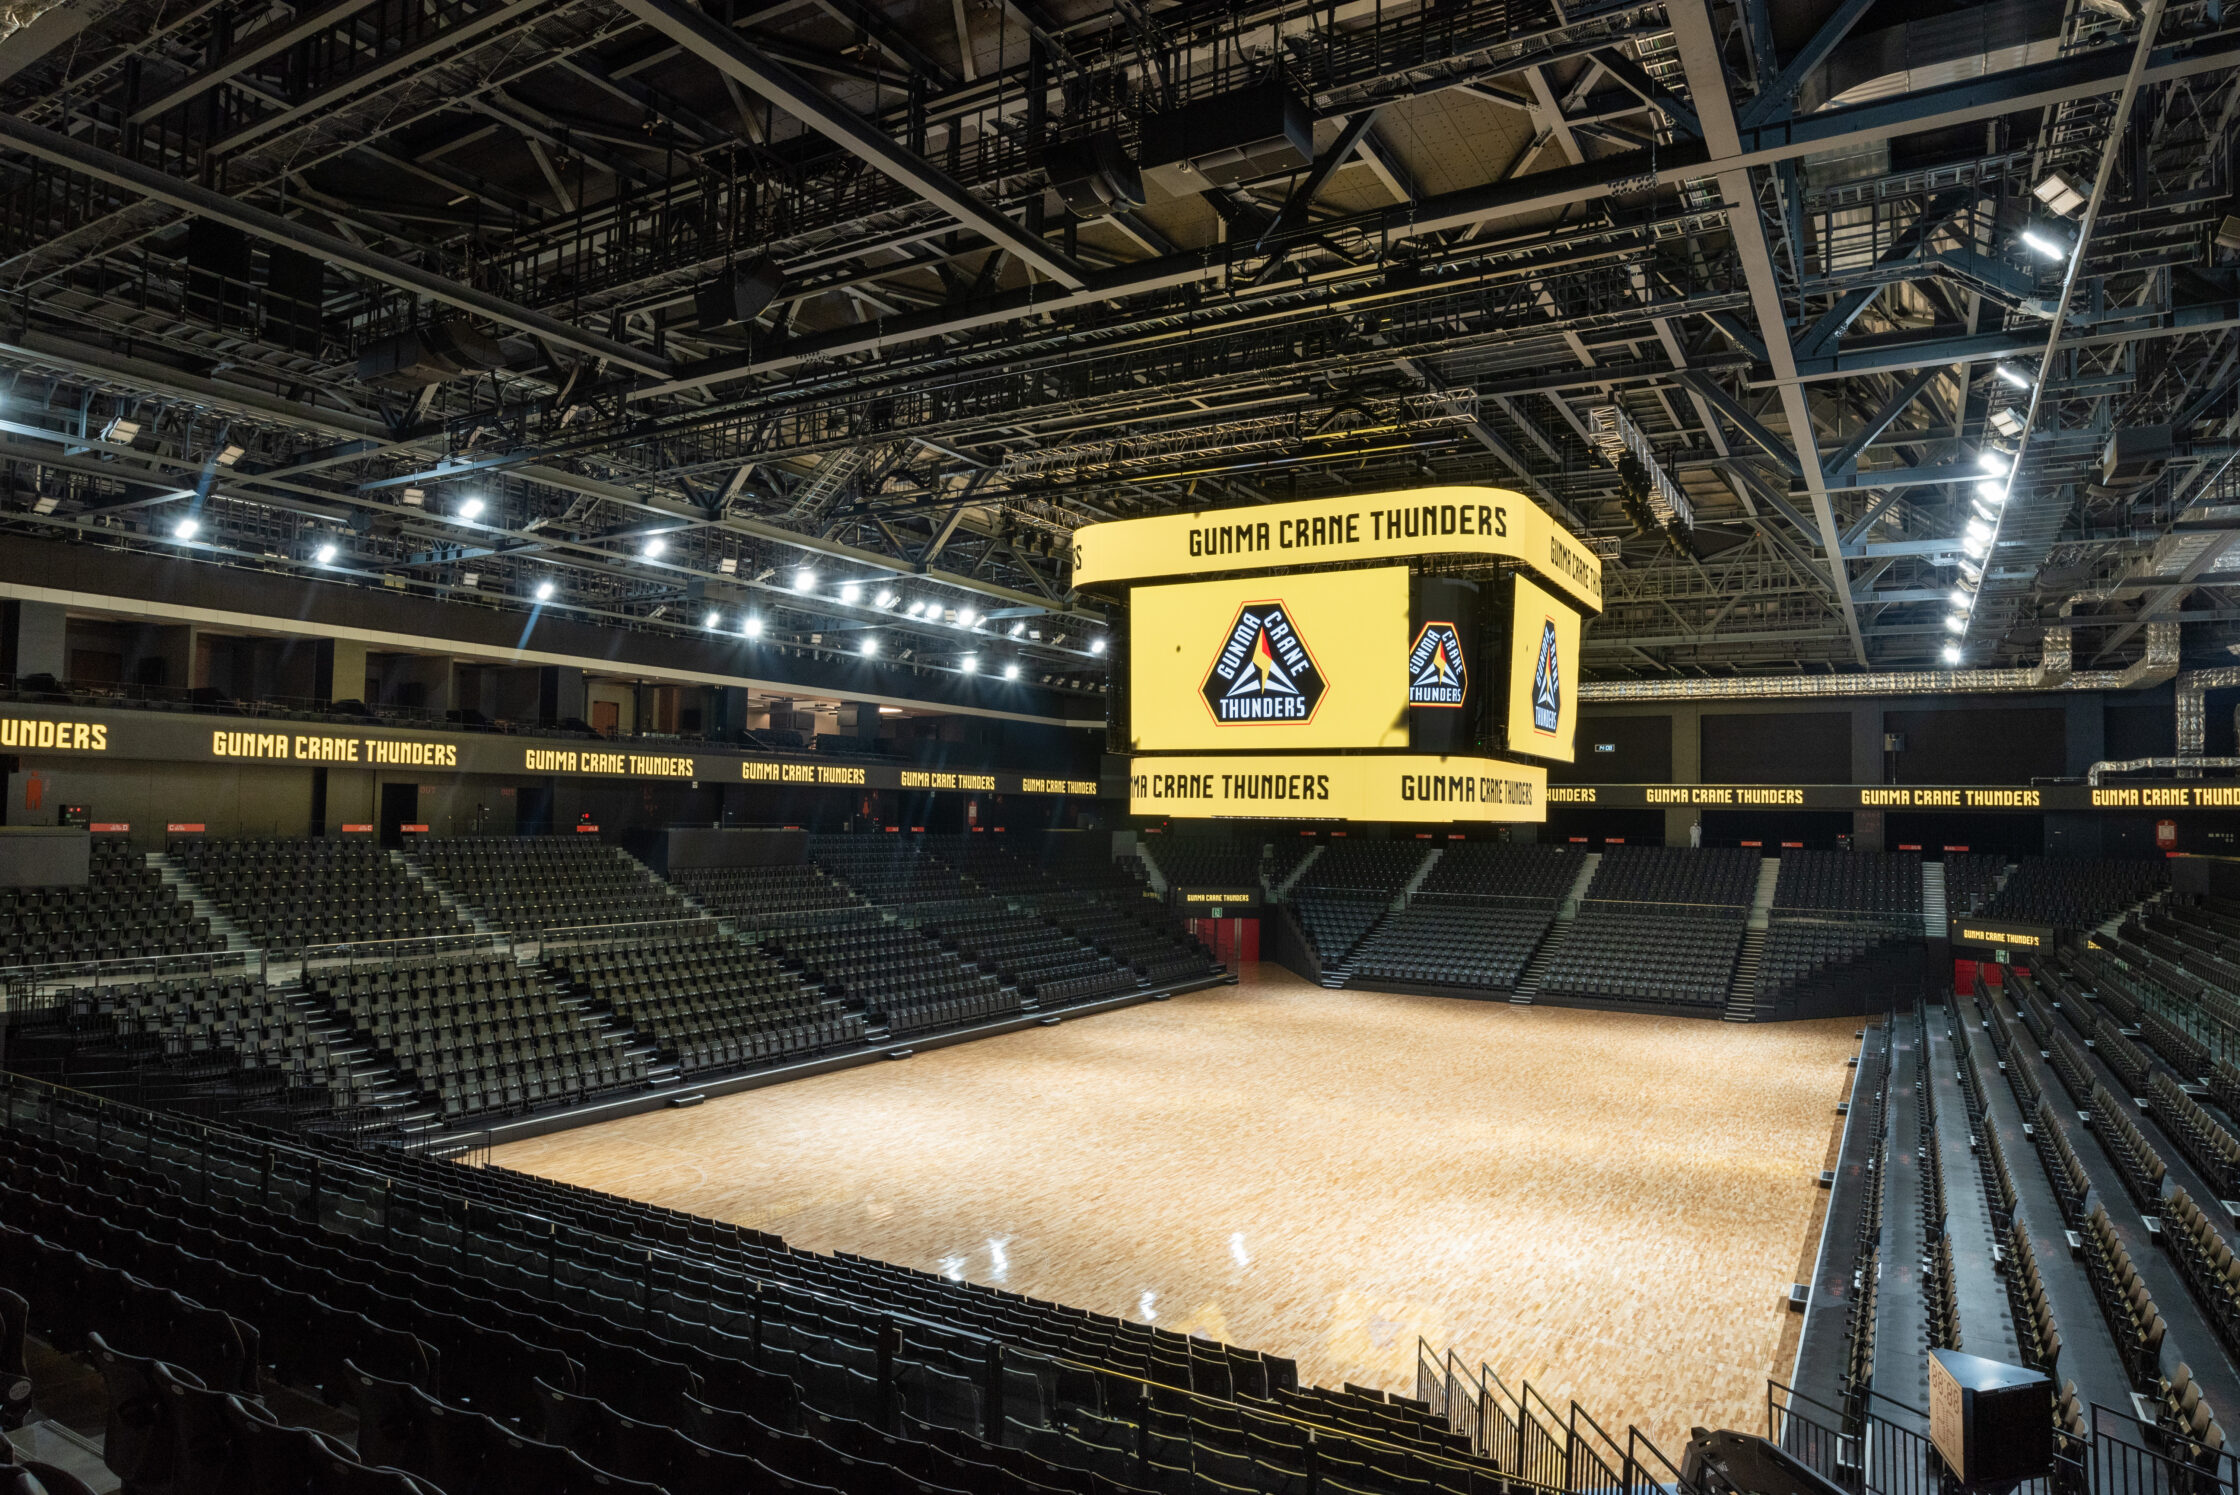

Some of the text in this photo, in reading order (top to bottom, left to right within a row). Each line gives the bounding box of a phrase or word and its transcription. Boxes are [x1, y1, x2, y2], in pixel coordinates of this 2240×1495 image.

[1189, 504, 1507, 557] GUNMA CRANE THUNDERS
[1551, 536, 1571, 577] GUNMA
[1572, 553, 1589, 590] CRANE
[1217, 611, 1310, 680] GUNMA CRANE
[1409, 629, 1463, 675] GUNMA CRANE
[1409, 687, 1461, 702] THUNDERS
[1219, 696, 1305, 719] THUNDERS
[1, 719, 107, 750] UNDERS
[212, 731, 457, 766] GUNMA CRANE THUNDERS
[525, 749, 694, 777] GUNMA CRANE THUNDERS
[742, 761, 865, 785] GUNMA CRANE THUNDERS
[901, 771, 995, 790] GUNMA CRANE THUNDERS
[1022, 778, 1097, 795] GUNMA CRANE THUNDERS
[1153, 774, 1214, 798] CRANE
[1222, 774, 1329, 800] THUNDERS
[1401, 774, 1533, 806] GUNMA CRANE THUNDERS
[1646, 788, 1803, 804] GUNMA CRANE THUNDERS
[1861, 789, 2040, 806] GUNMA CRANE THUNDERS
[2092, 787, 2240, 806] GUNMA CRANE THUND
[1187, 894, 1249, 902] GUNMA CRANE THUNDERS
[1963, 929, 1985, 940] GUNMA
[1985, 931, 2006, 943] CRANE
